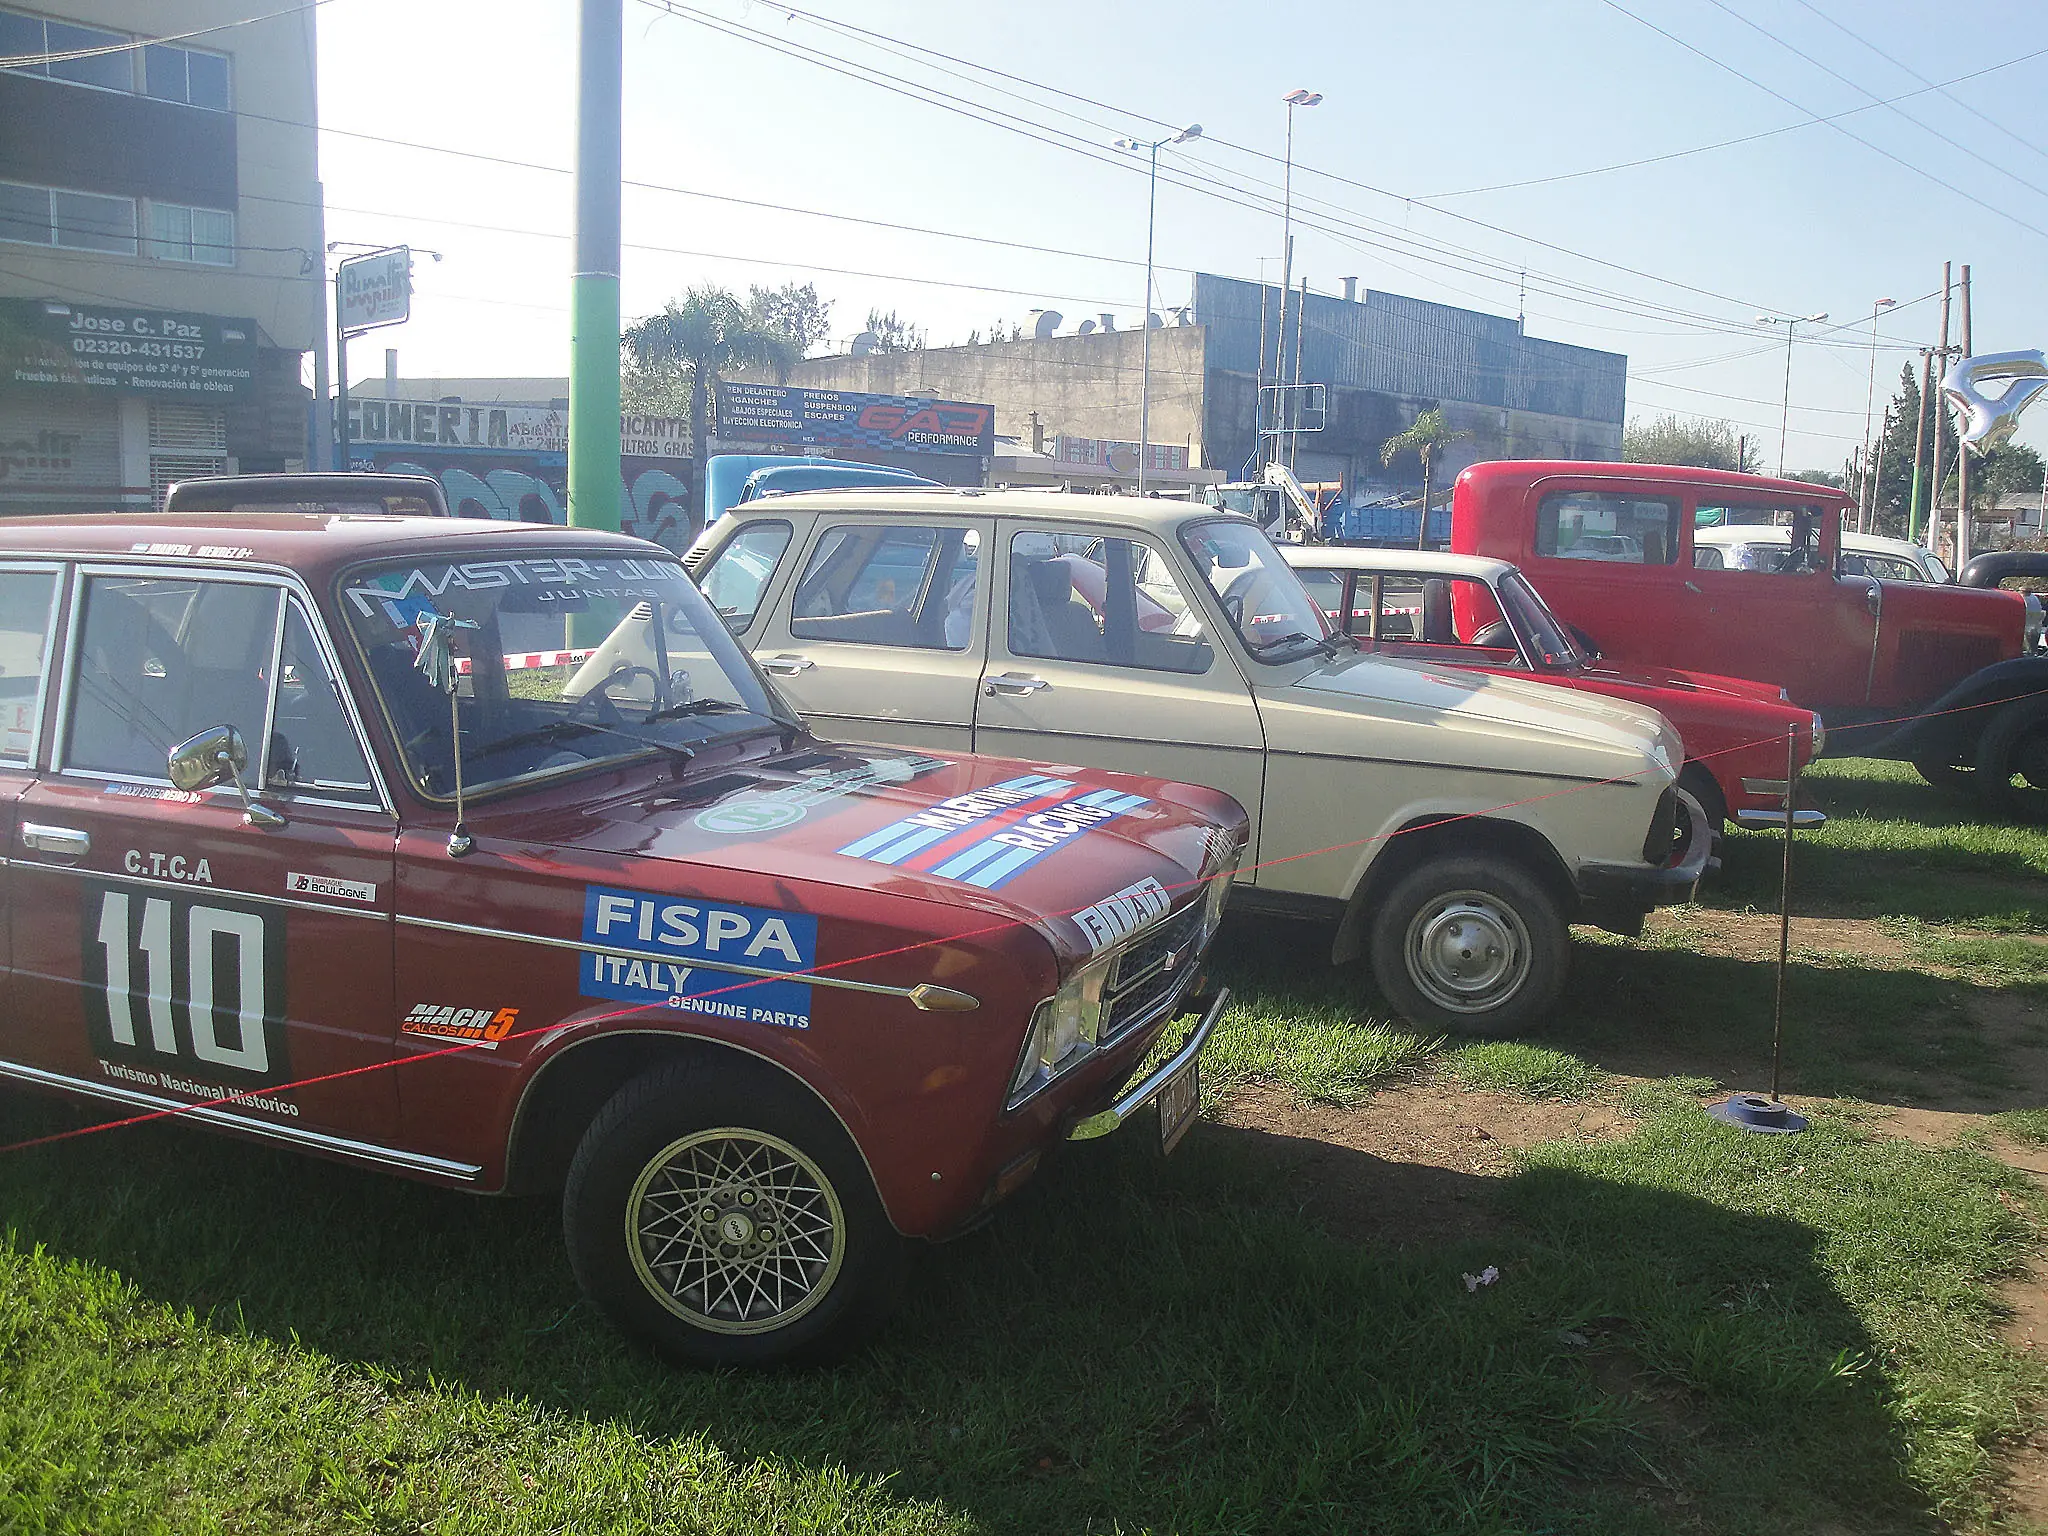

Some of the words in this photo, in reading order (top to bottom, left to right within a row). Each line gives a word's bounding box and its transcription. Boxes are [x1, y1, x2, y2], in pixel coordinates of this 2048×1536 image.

[70, 313, 126, 332] Jose
[132, 317, 155, 334] C.
[162, 320, 202, 338] Paz
[73, 338, 205, 359] 02320-431537
[803, 392, 839, 401] FRENOS
[803, 402, 857, 412] SUSPENSION
[804, 412, 845, 421] ESCAPES
[908, 431, 978, 447] PERFORMANCE
[538, 588, 659, 601] JUNTAS
[904, 785, 1037, 832] MARTINI
[991, 802, 1112, 852] RACING
[124, 850, 213, 883] C.T.C.A
[312, 884, 367, 899] BOULOGNE
[596, 895, 802, 963] FISPA
[1084, 884, 1164, 948] FIAT
[98, 891, 268, 1073] 110
[595, 954, 693, 994] ITALY
[404, 1003, 493, 1028] MACH
[484, 1007, 519, 1041] 5
[668, 995, 747, 1019] GENUINE
[752, 1008, 809, 1029] PARTS
[401, 1022, 458, 1036] CALCOS
[100, 1059, 158, 1086] Turismo
[160, 1072, 226, 1101] Nacional
[230, 1086, 299, 1116] Historico
